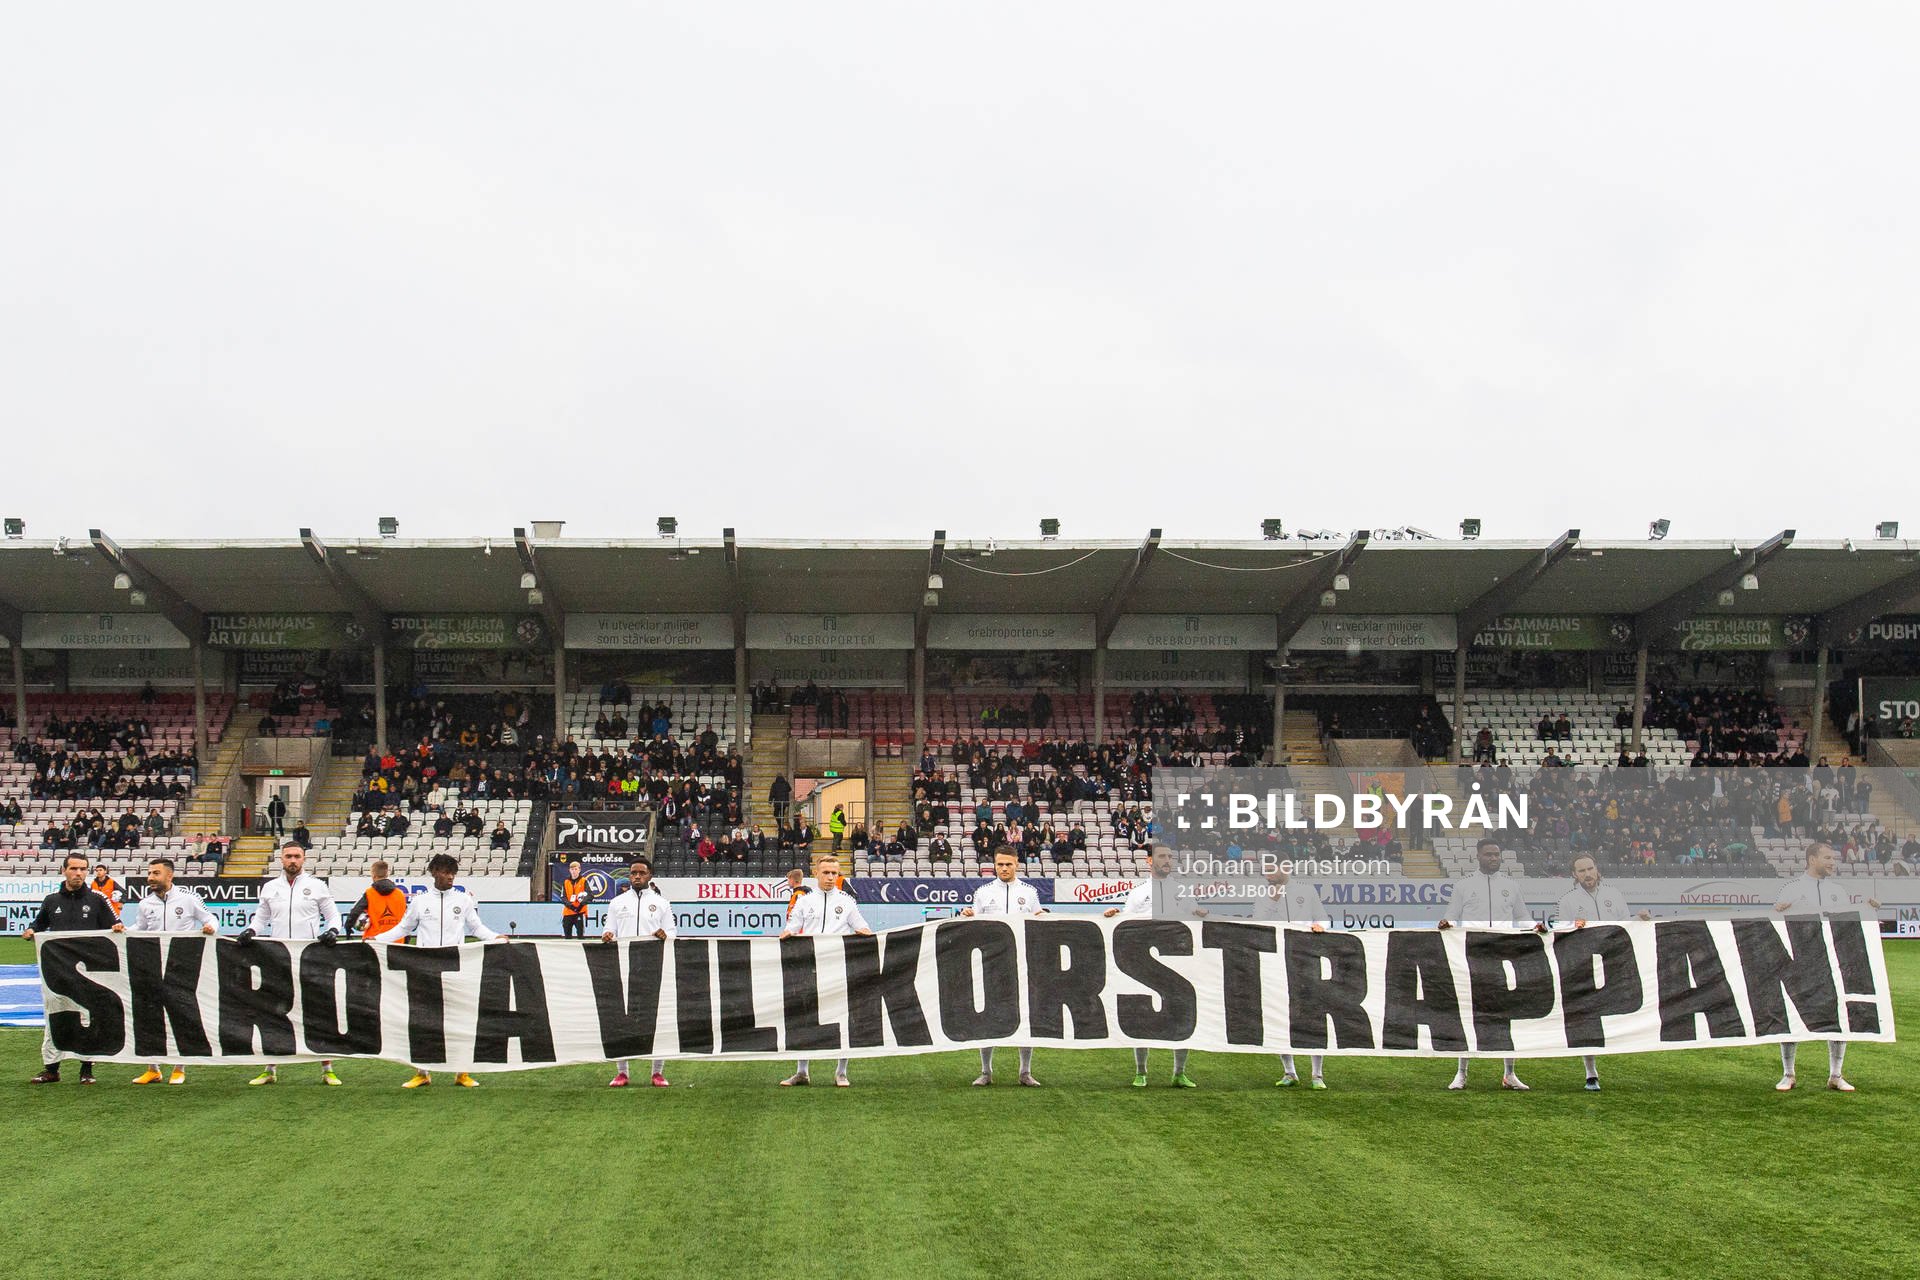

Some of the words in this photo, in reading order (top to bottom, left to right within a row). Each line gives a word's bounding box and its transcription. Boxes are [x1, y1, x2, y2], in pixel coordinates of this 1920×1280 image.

[207, 616, 315, 630] TILLSAMMANS
[457, 616, 505, 633] HJÄRTA
[598, 619, 609, 631] Vi
[612, 619, 660, 631] utvecklar
[663, 619, 700, 633] miljöer
[1321, 620, 1332, 631] Vi
[1335, 620, 1384, 632] utvecklar
[1386, 620, 1424, 634] miljöer
[60, 633, 152, 645] ÖREBROPORTEN
[207, 629, 229, 645] ÄR
[232, 632, 246, 645] VI
[249, 631, 287, 645] ALLT.
[449, 631, 504, 644] PASSION
[597, 634, 619, 645] som
[622, 632, 662, 645] stärker
[664, 631, 702, 645] Örebro
[785, 632, 875, 645] ÖREBROPORTEN
[968, 626, 1055, 639] örebroporten.se
[1146, 633, 1238, 646] ÖREBROPORTEN
[1320, 635, 1343, 646] som
[1387, 633, 1425, 646] Örebro
[1497, 632, 1512, 646] VI
[1515, 632, 1553, 646] ALLT.
[1715, 634, 1771, 645] PASSION
[91, 665, 193, 679] ÖREBROPORTE
[1879, 700, 1920, 720] STO
[558, 817, 648, 845] Printoz
[697, 883, 773, 899] BEHRN
[913, 884, 959, 903] Care
[1074, 880, 1136, 902] Radiator
[728, 909, 782, 928] inom
[41, 934, 557, 1064] SKROTA
[583, 911, 1882, 1059] VILLKORSTRAPPAN!
